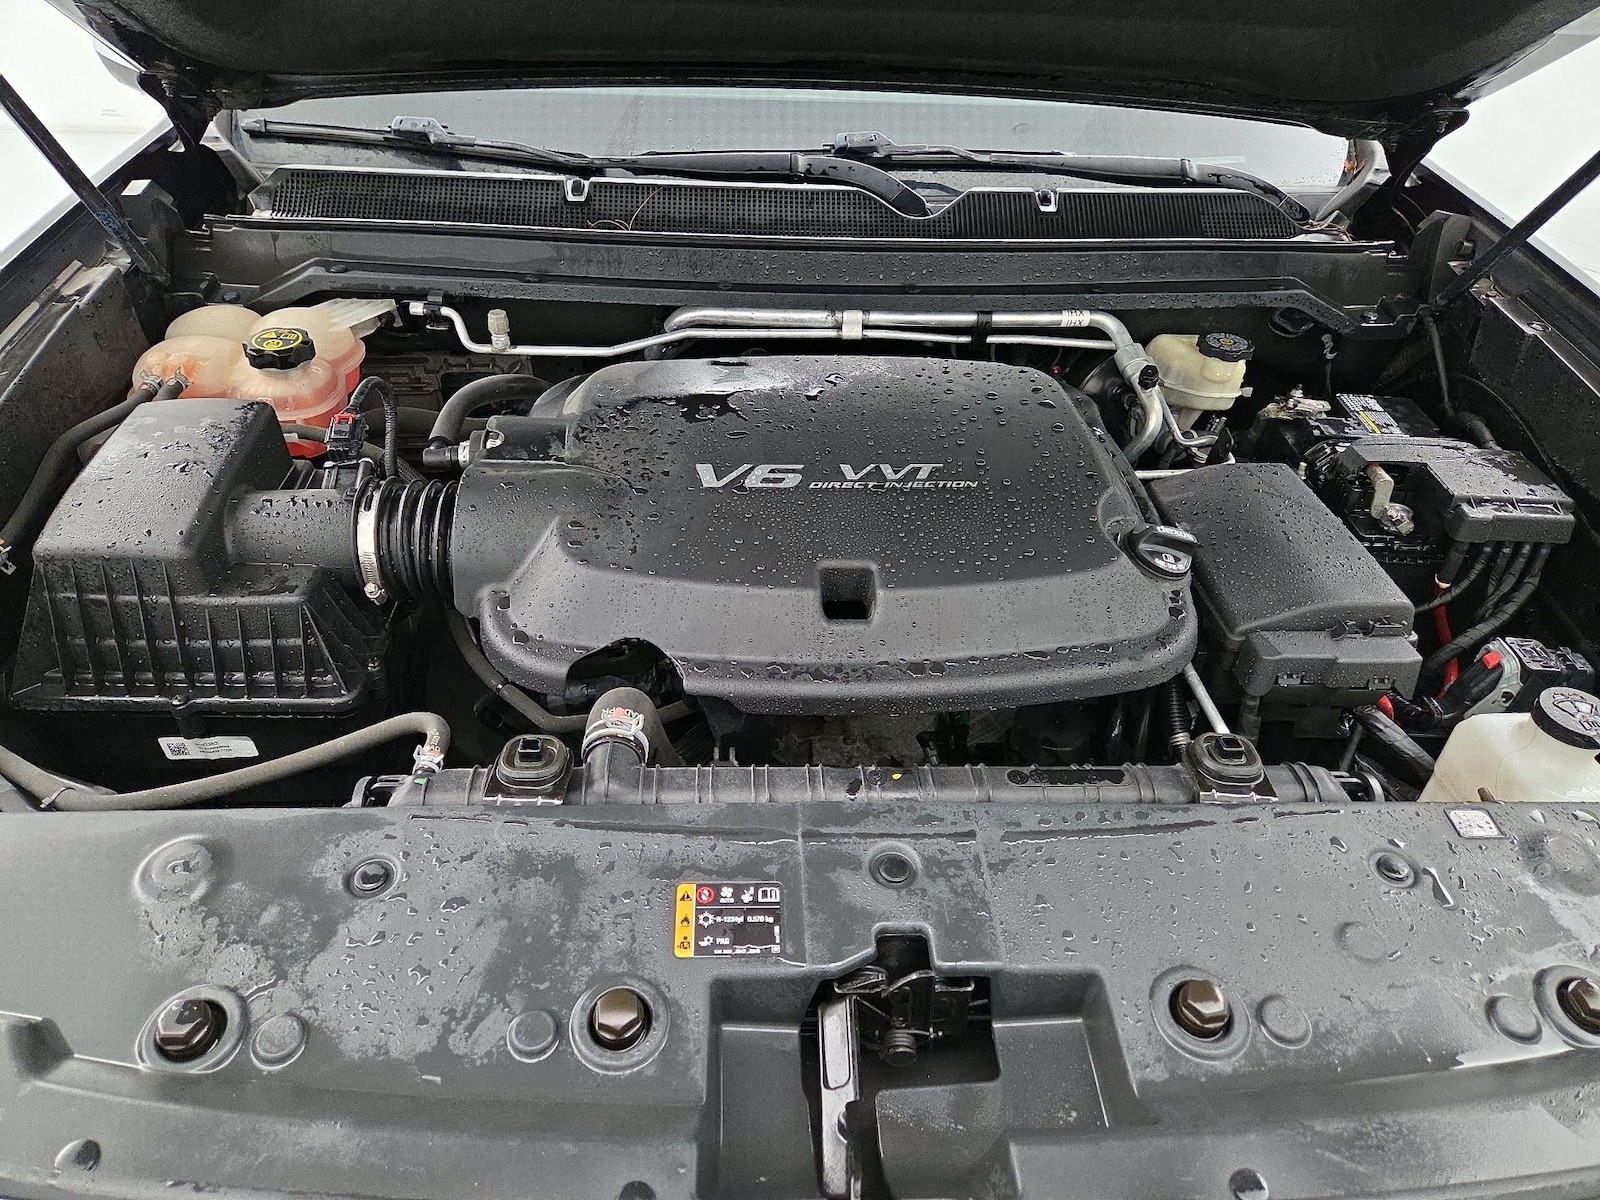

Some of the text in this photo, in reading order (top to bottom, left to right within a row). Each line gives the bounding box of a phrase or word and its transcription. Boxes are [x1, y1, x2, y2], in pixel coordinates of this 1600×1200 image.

[695, 463, 943, 488] V6 VVT
[808, 480, 980, 489] DIRECT INJECTION
[747, 915, 765, 923] 0.570
[765, 915, 774, 924] kg
[716, 937, 730, 945] PAG
